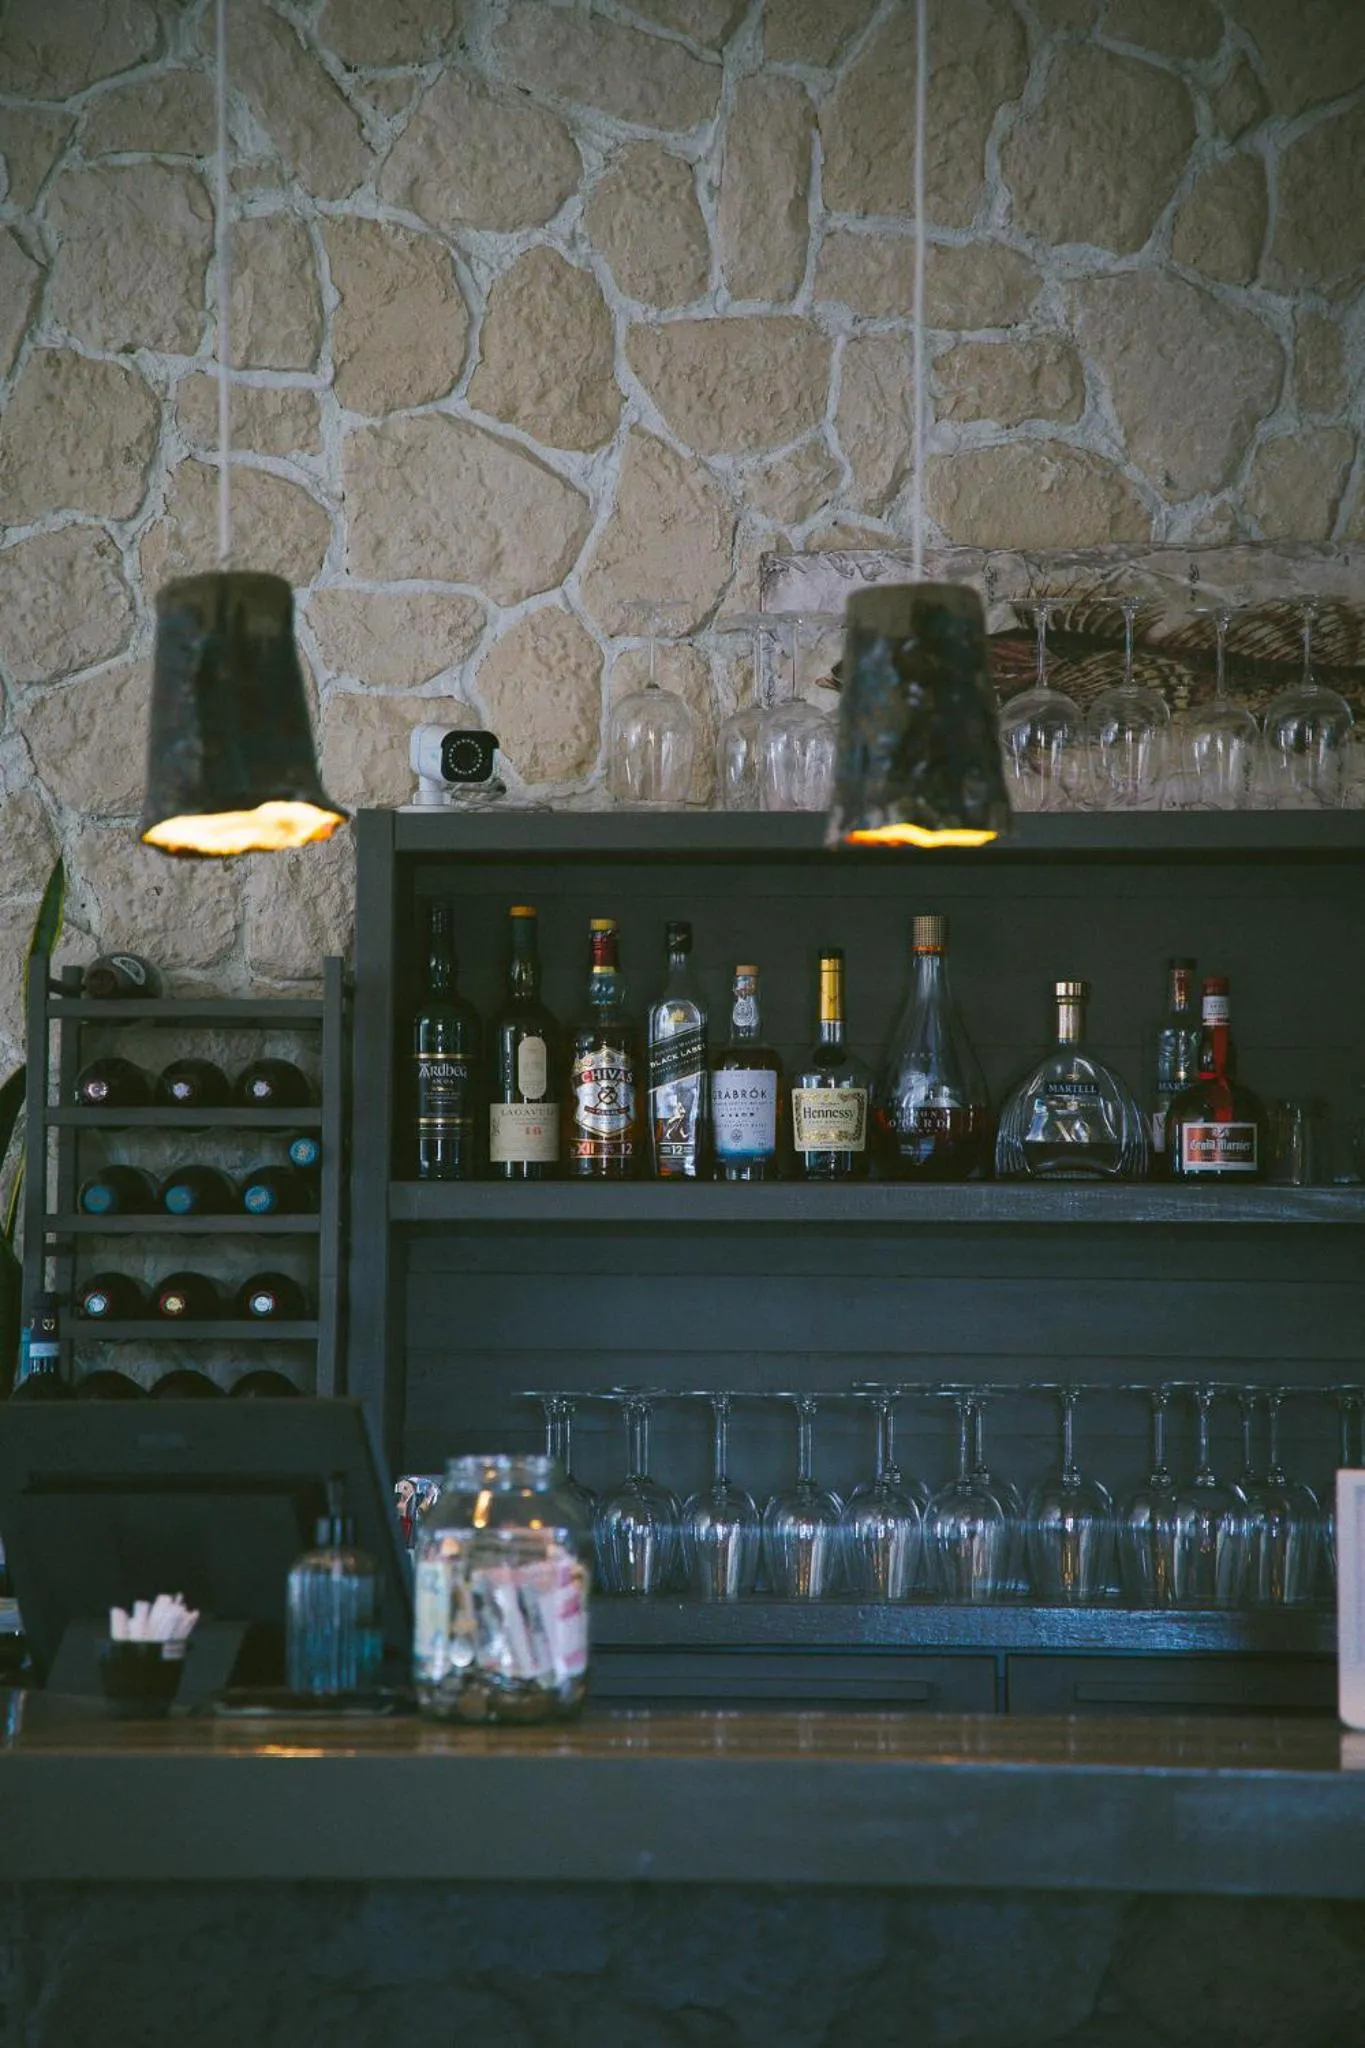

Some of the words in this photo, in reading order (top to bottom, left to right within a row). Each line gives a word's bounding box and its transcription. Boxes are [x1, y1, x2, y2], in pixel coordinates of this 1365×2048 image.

[649, 1054, 679, 1069] BLACK
[680, 1042, 707, 1057] LABEL
[581, 1067, 634, 1085] CHIVAS
[1048, 1084, 1097, 1093] MARTELL
[803, 1106, 854, 1121] Hennessy
[577, 1142, 595, 1155] XII
[621, 1142, 634, 1155] 12
[671, 1145, 683, 1155] 12
[1190, 1139, 1217, 1151] Grand
[1218, 1139, 1252, 1152] Marnier
